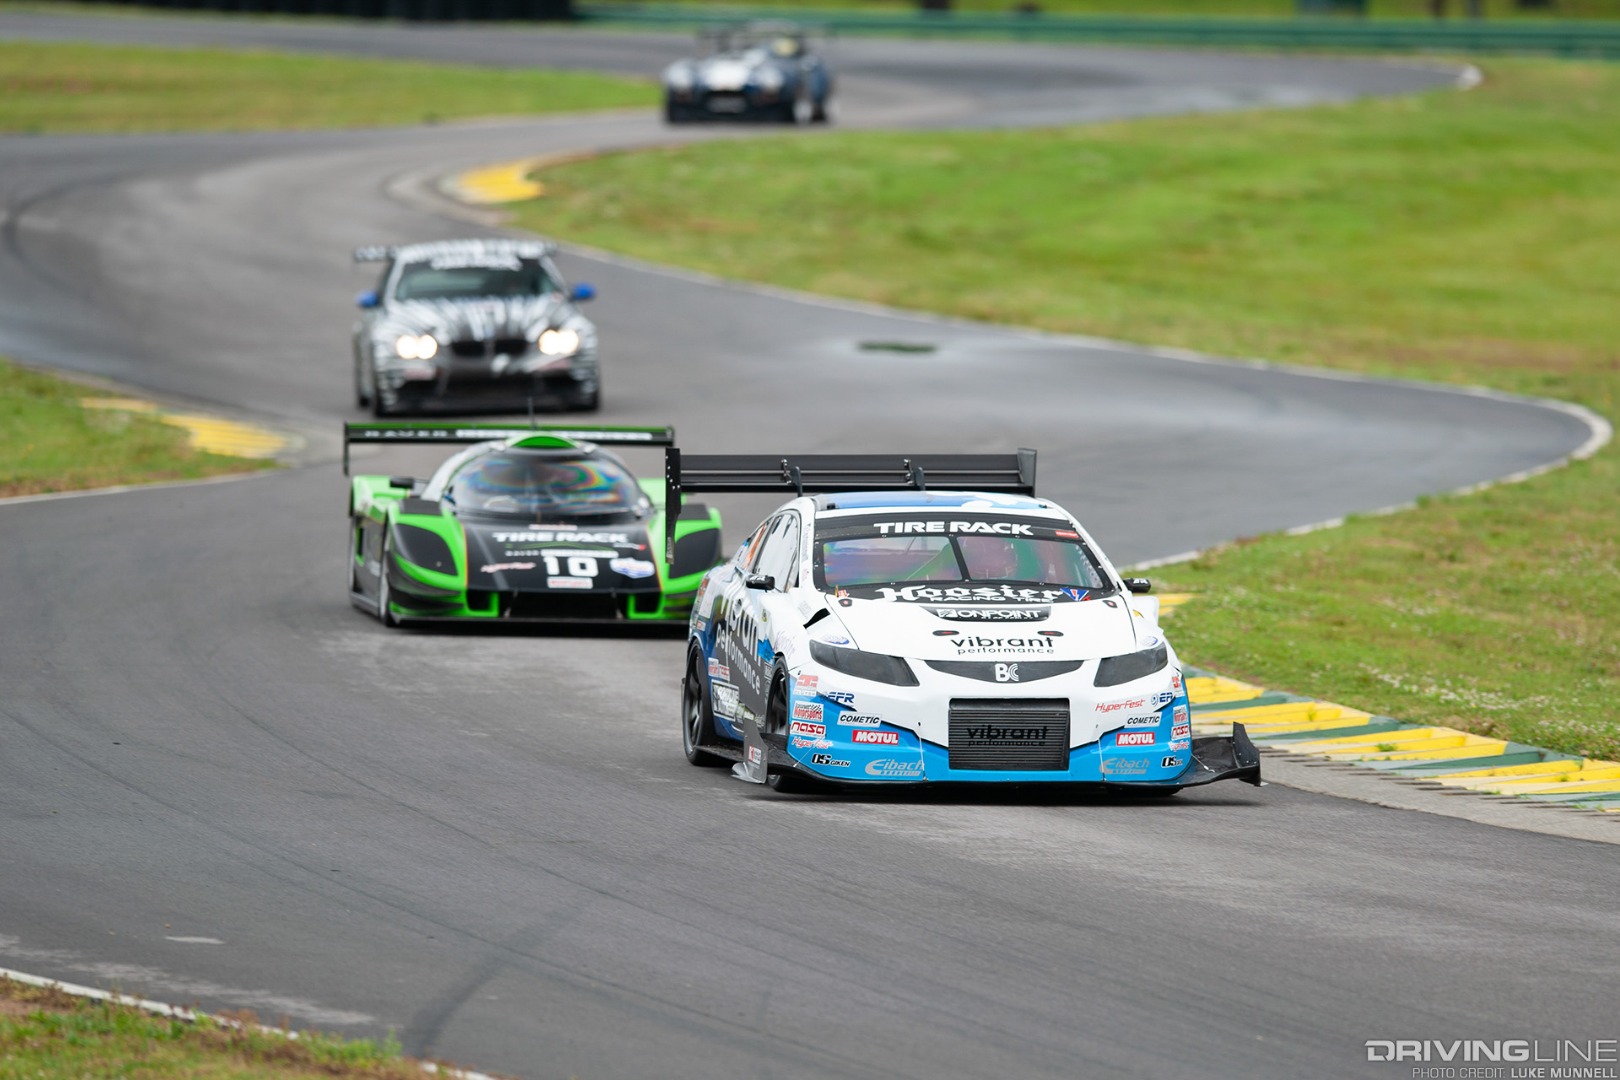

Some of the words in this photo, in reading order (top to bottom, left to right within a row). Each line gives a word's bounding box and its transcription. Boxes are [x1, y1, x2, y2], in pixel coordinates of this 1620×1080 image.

[873, 521, 945, 534] TIRE
[950, 521, 1034, 536] RACK
[492, 532, 554, 542] TIRE
[555, 532, 629, 543] RACK
[875, 585, 1063, 602] Hoosier
[957, 610, 1042, 619] ONPOINT
[951, 637, 1053, 647] vibrant
[715, 622, 760, 696] performance
[1095, 700, 1146, 713] HyperFest
[840, 714, 880, 724] COMETIC
[1127, 716, 1160, 725] COMETIC
[856, 732, 898, 743] MOTUL
[966, 725, 1048, 740] vibrant
[1118, 733, 1154, 745] MOTUL
[865, 759, 924, 776] Eibach
[1101, 757, 1150, 773] Eibach
